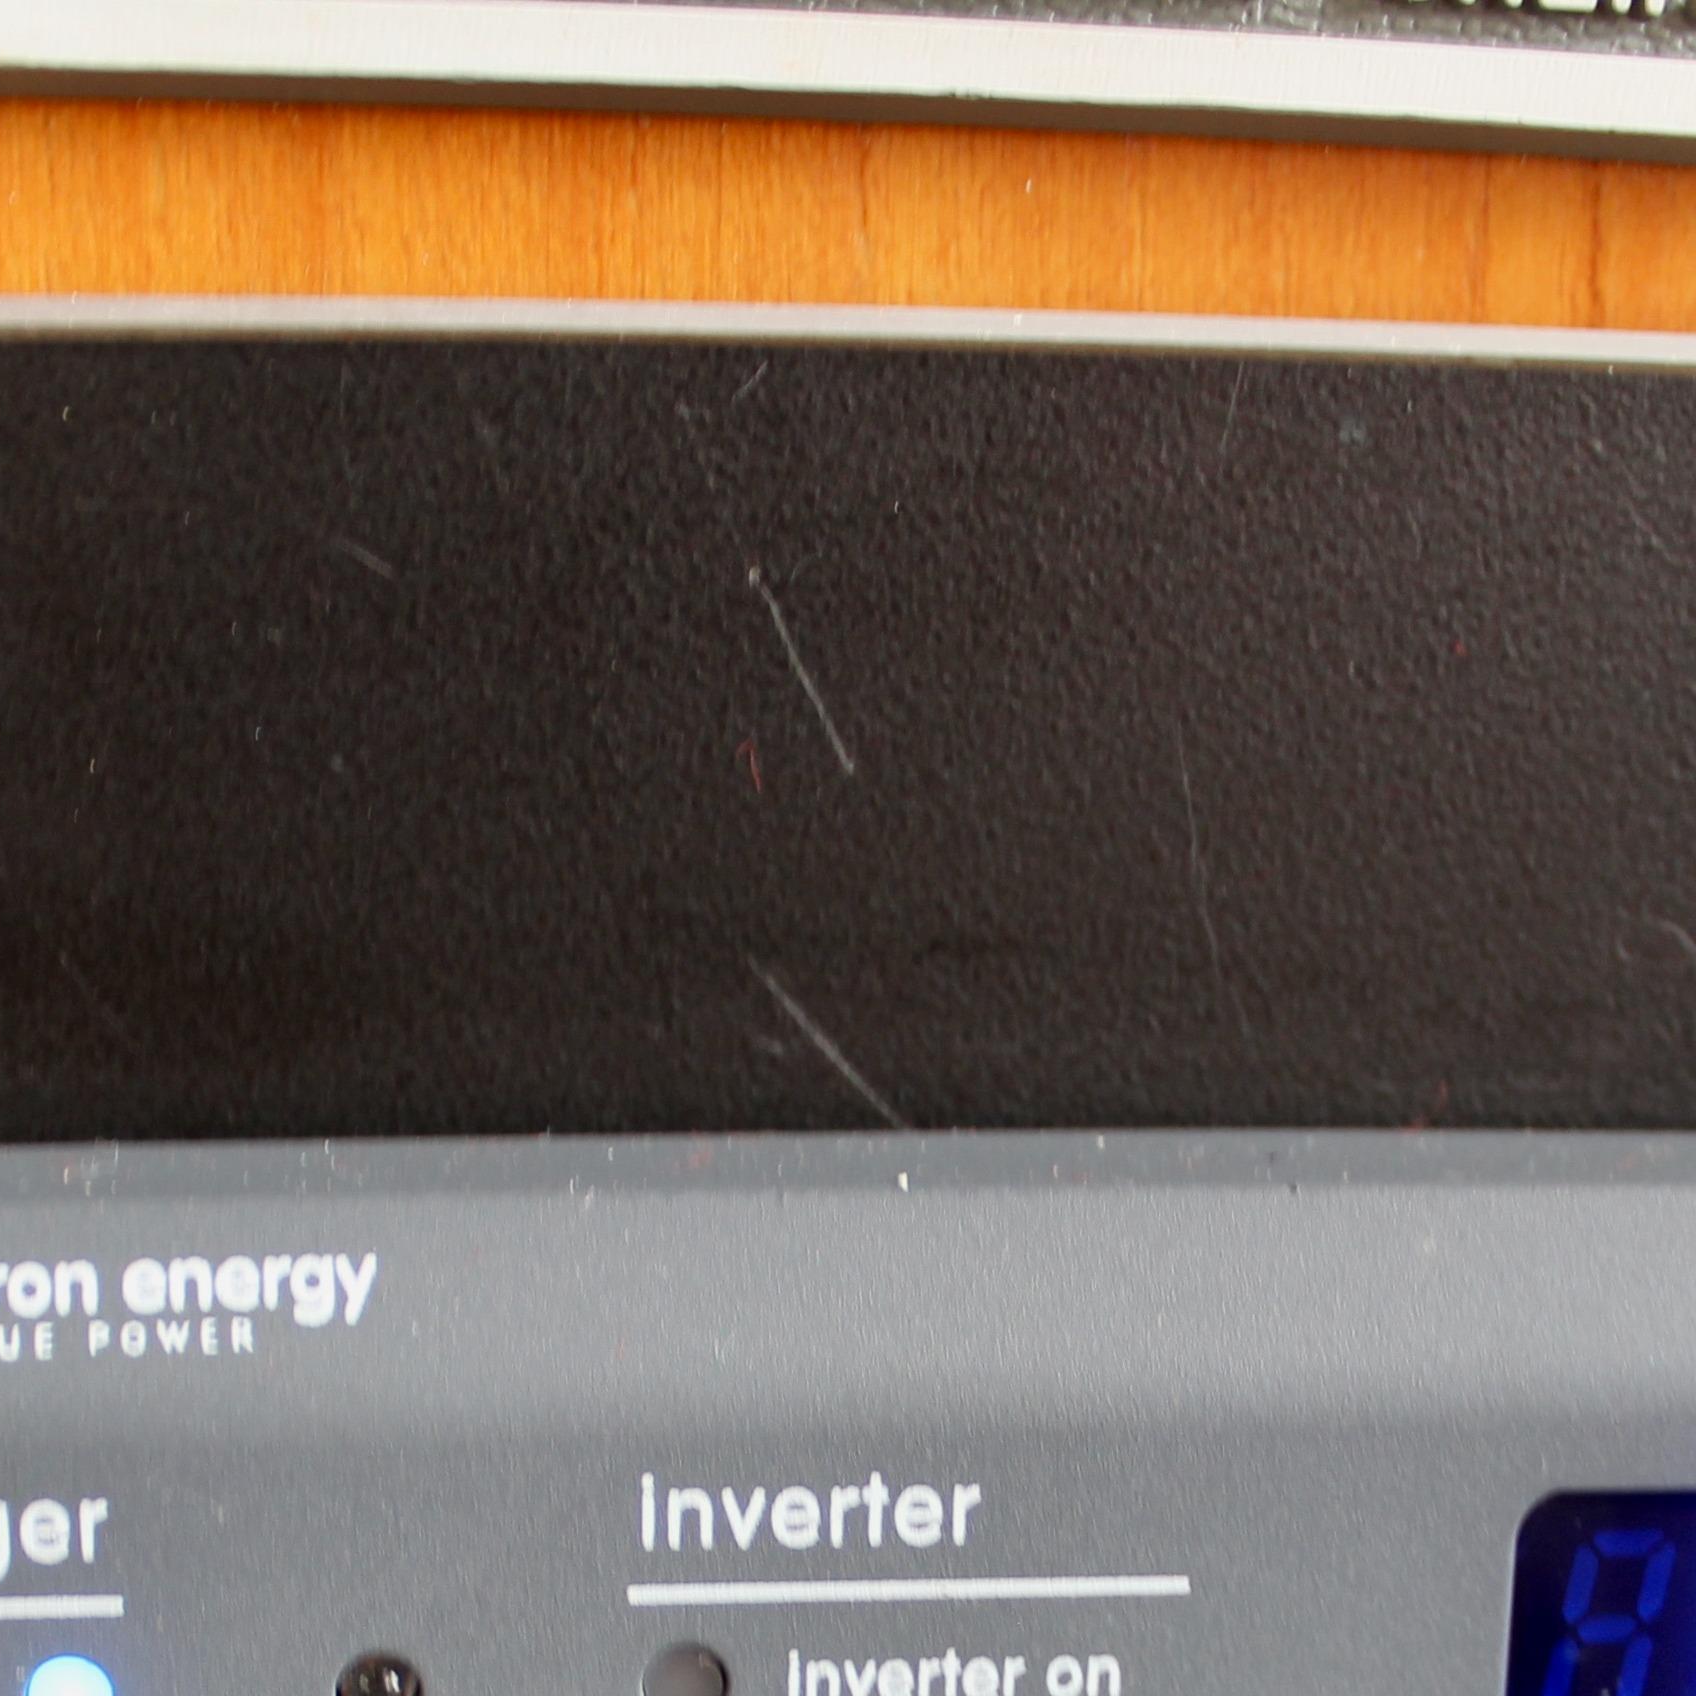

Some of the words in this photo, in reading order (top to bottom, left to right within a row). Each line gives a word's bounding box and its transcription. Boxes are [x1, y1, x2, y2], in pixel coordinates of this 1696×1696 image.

[122, 1251, 377, 1327] energy
[88, 1316, 256, 1358] POWER
[640, 1471, 982, 1552] inverter
